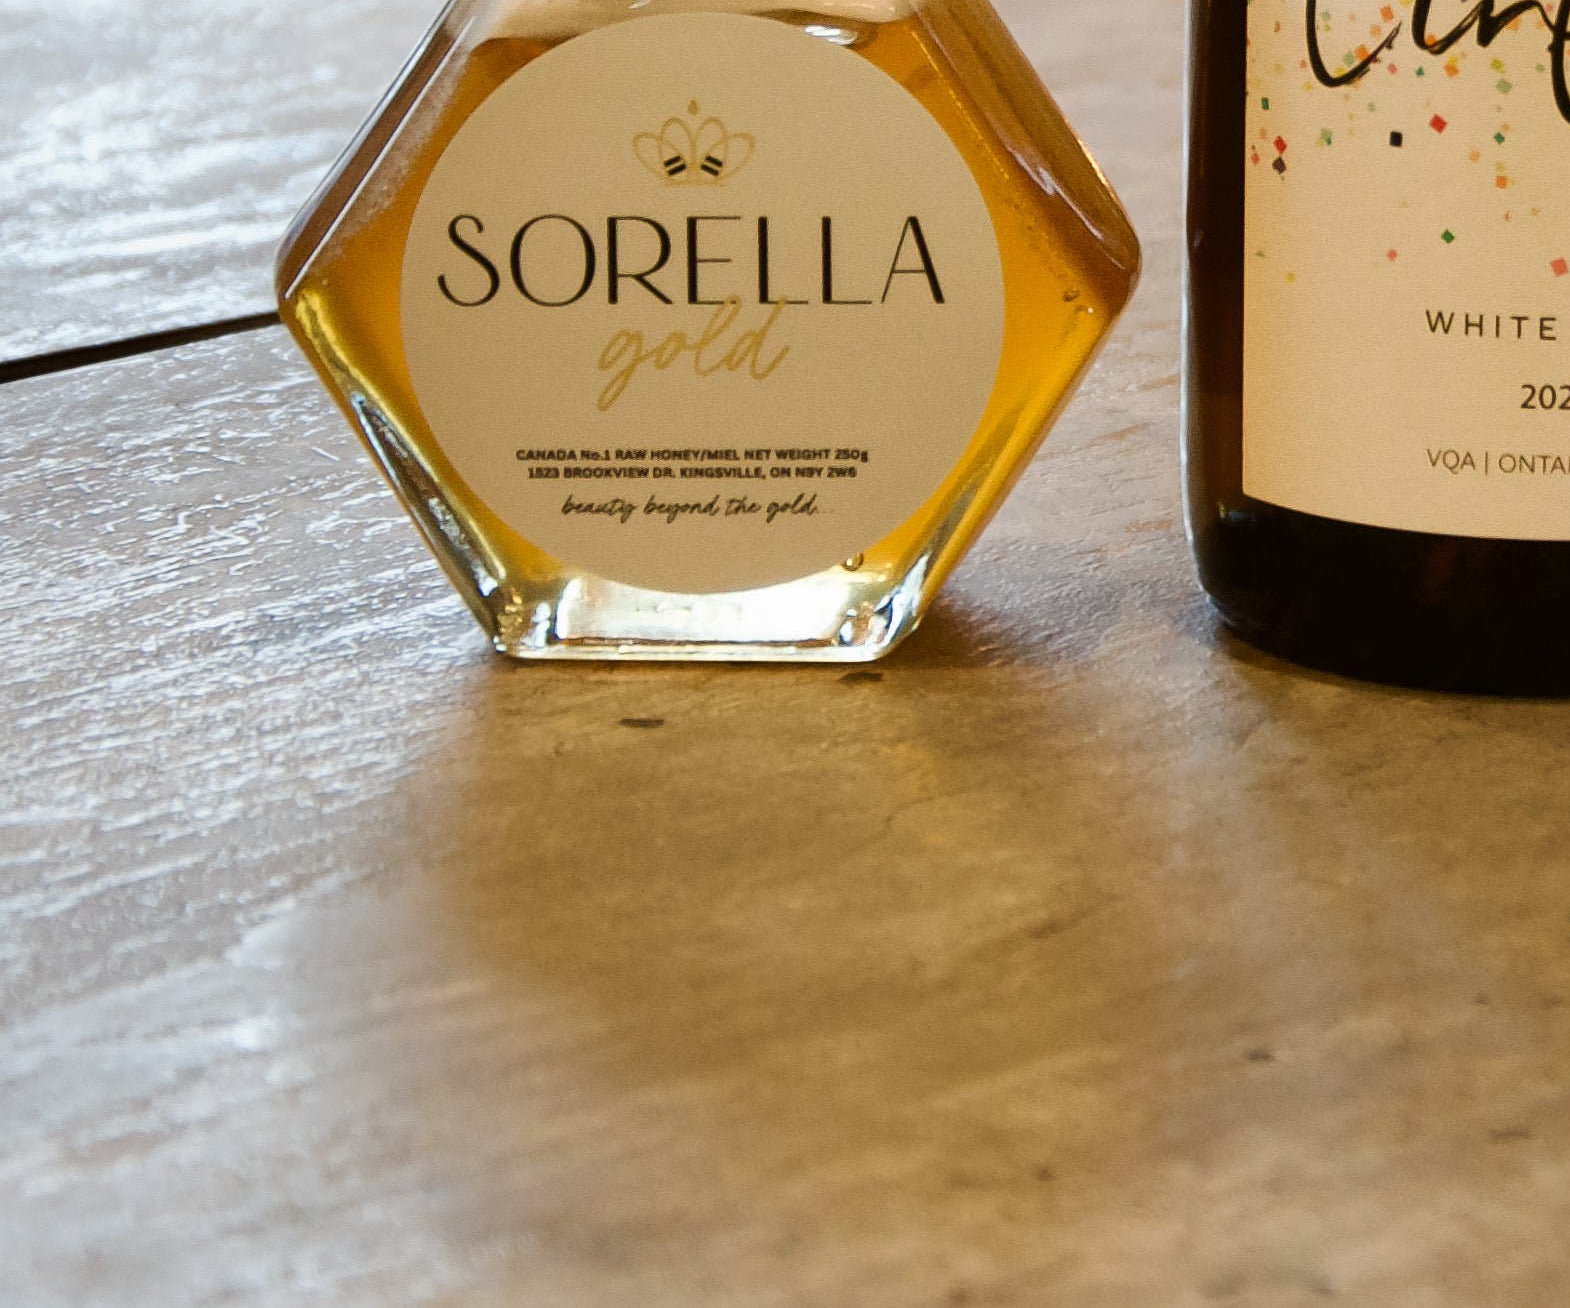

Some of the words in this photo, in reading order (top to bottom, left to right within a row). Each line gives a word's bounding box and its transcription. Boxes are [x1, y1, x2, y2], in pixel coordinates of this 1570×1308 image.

[437, 213, 946, 307] SORELLA
[1426, 309, 1557, 341] WHITE
[597, 294, 791, 412] gold
[515, 449, 577, 461] CANADA
[615, 449, 647, 461] RAW
[651, 449, 740, 461] HONEY/MIEL
[744, 449, 771, 461] NET
[775, 449, 830, 461] WEIGHT
[1426, 449, 1476, 475] VQA
[563, 467, 650, 479] BROOKVIEW
[652, 467, 676, 479] DR.
[680, 467, 766, 480] KINGSVILLE,
[769, 467, 791, 479] ON
[561, 493, 638, 524] beauty
[643, 494, 720, 524] beyond
[724, 495, 762, 517] the
